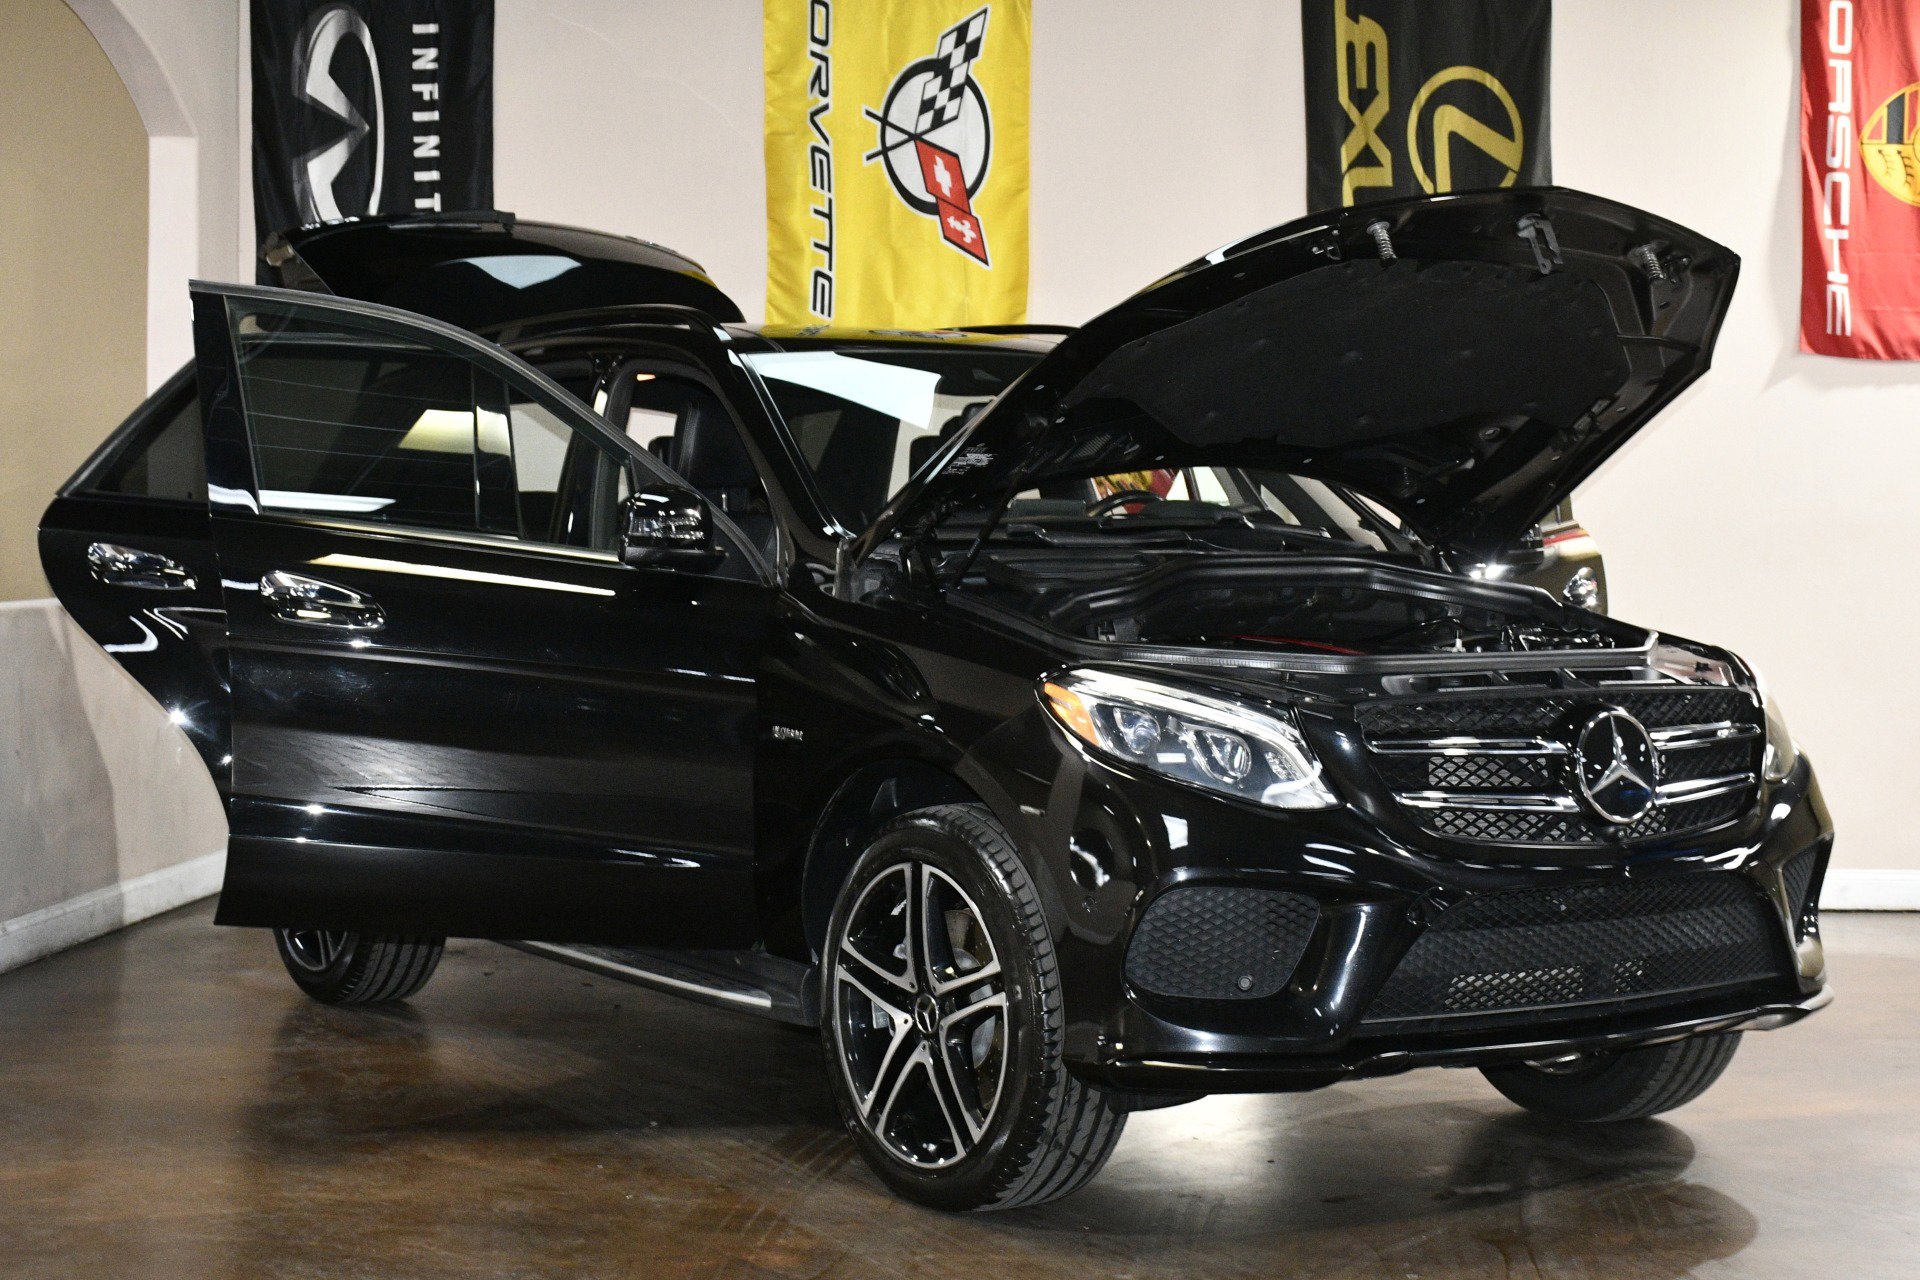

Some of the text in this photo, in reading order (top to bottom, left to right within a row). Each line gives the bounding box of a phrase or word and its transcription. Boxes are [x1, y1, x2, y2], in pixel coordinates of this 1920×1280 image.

[411, 22, 441, 212] INFINIT
[808, 0, 834, 318] ORVETTE
[1823, 0, 1852, 337] ORSCHE
